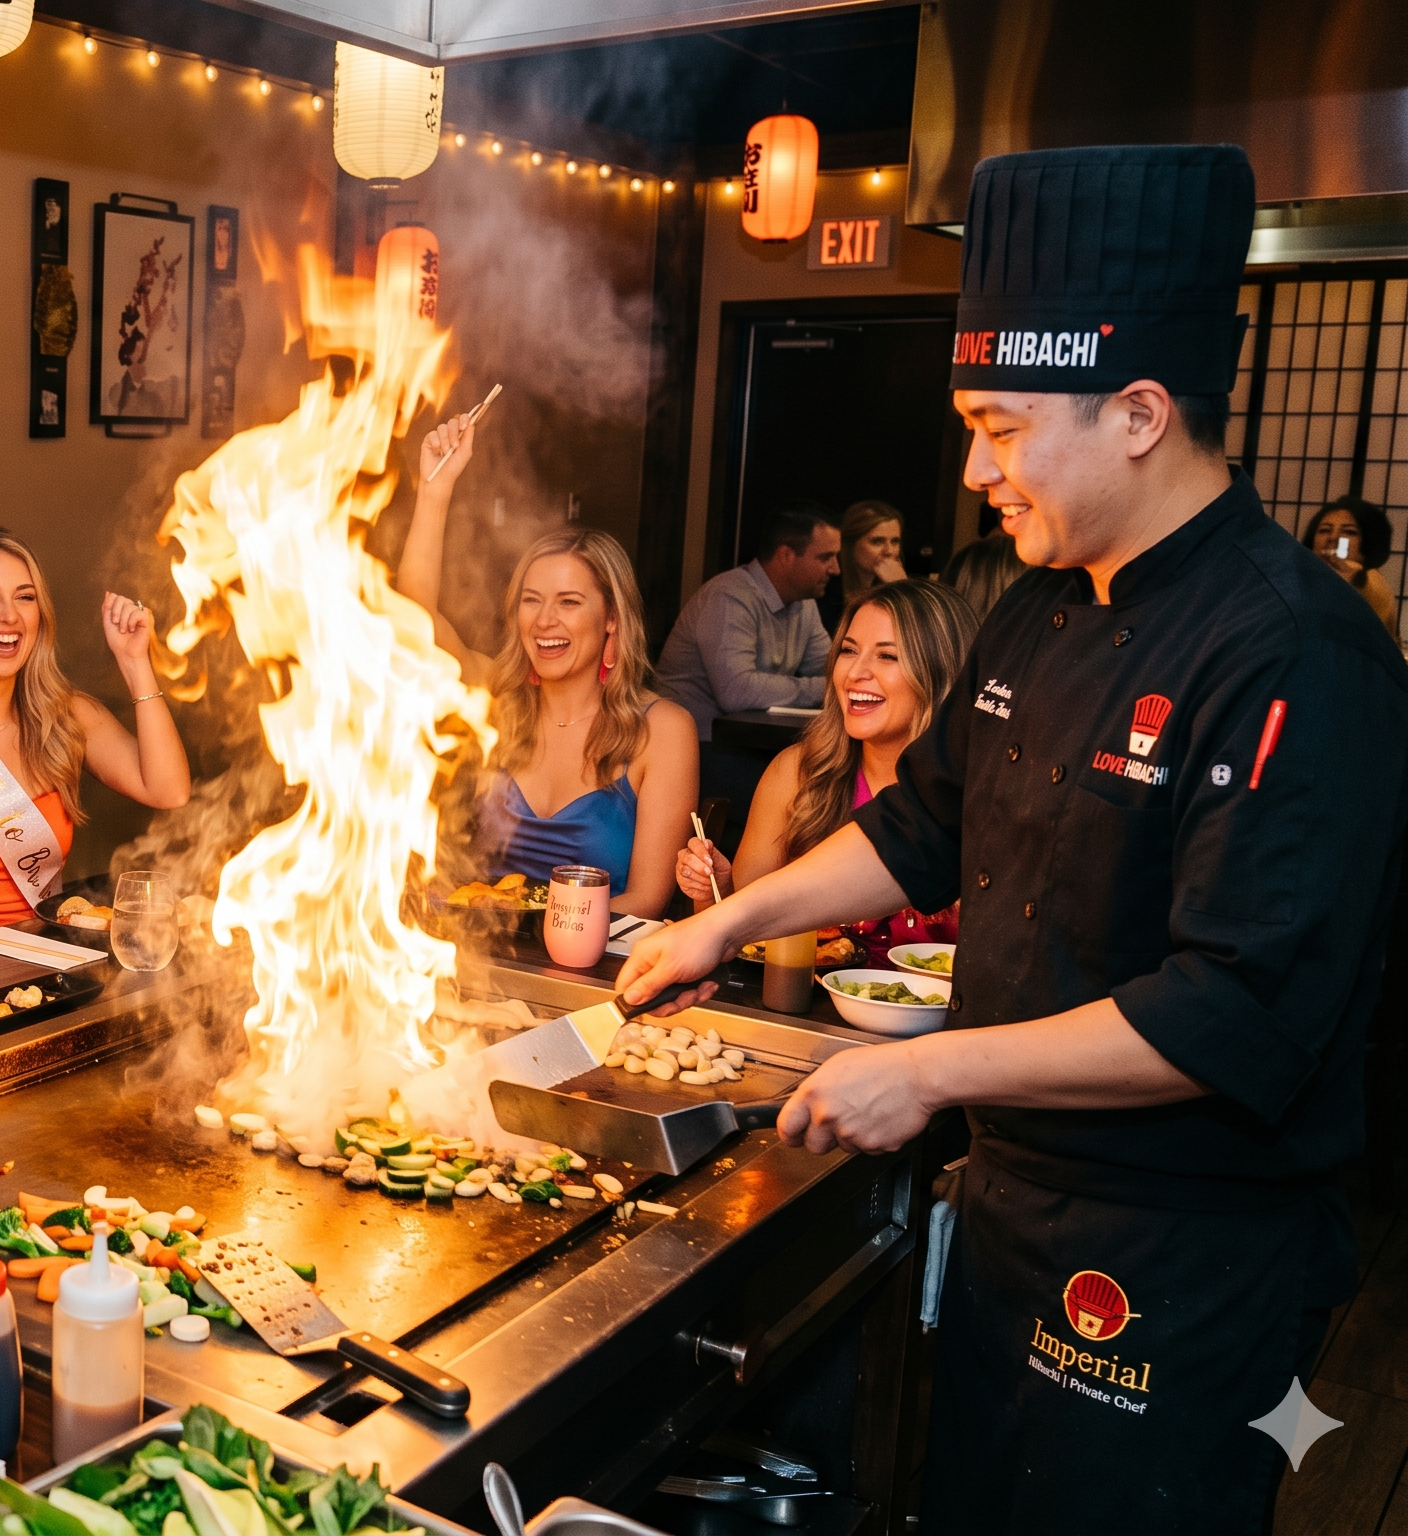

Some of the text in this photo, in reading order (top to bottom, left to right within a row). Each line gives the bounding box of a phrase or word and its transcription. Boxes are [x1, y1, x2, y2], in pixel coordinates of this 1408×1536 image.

[820, 219, 880, 265] EXIT
[996, 331, 1099, 367] HIBACHI
[1092, 750, 1127, 776] LOVE
[1030, 1317, 1151, 1393] Imperial
[1069, 1377, 1111, 1404] Private
[1113, 1395, 1148, 1415] Chef
